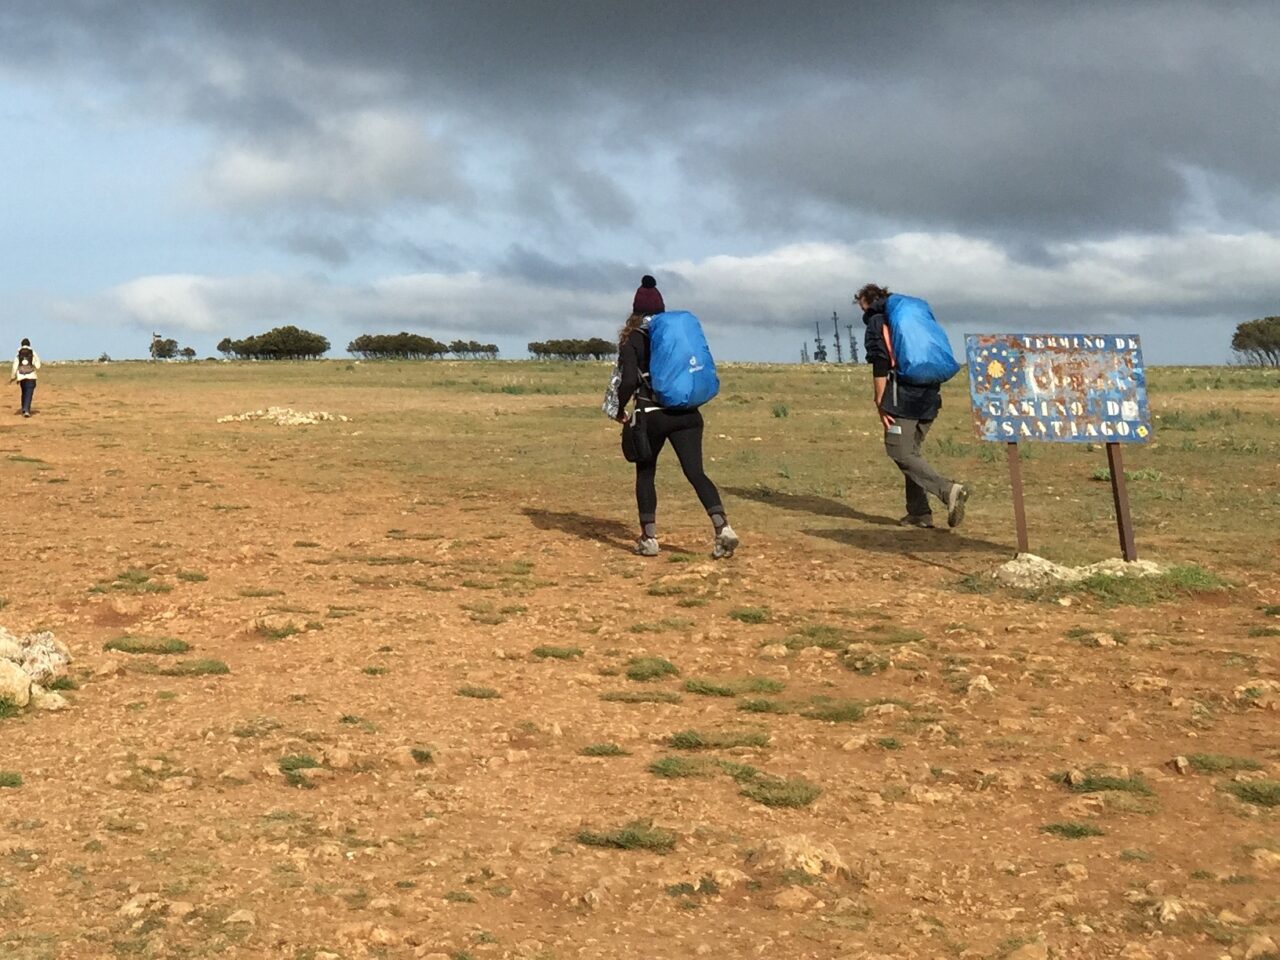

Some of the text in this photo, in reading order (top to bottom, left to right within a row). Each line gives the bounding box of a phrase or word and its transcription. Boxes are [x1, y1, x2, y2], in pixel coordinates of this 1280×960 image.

[1116, 337, 1138, 350] DE
[989, 401, 1083, 416] CAMINO
[1002, 421, 1130, 436] SANTIAGO
